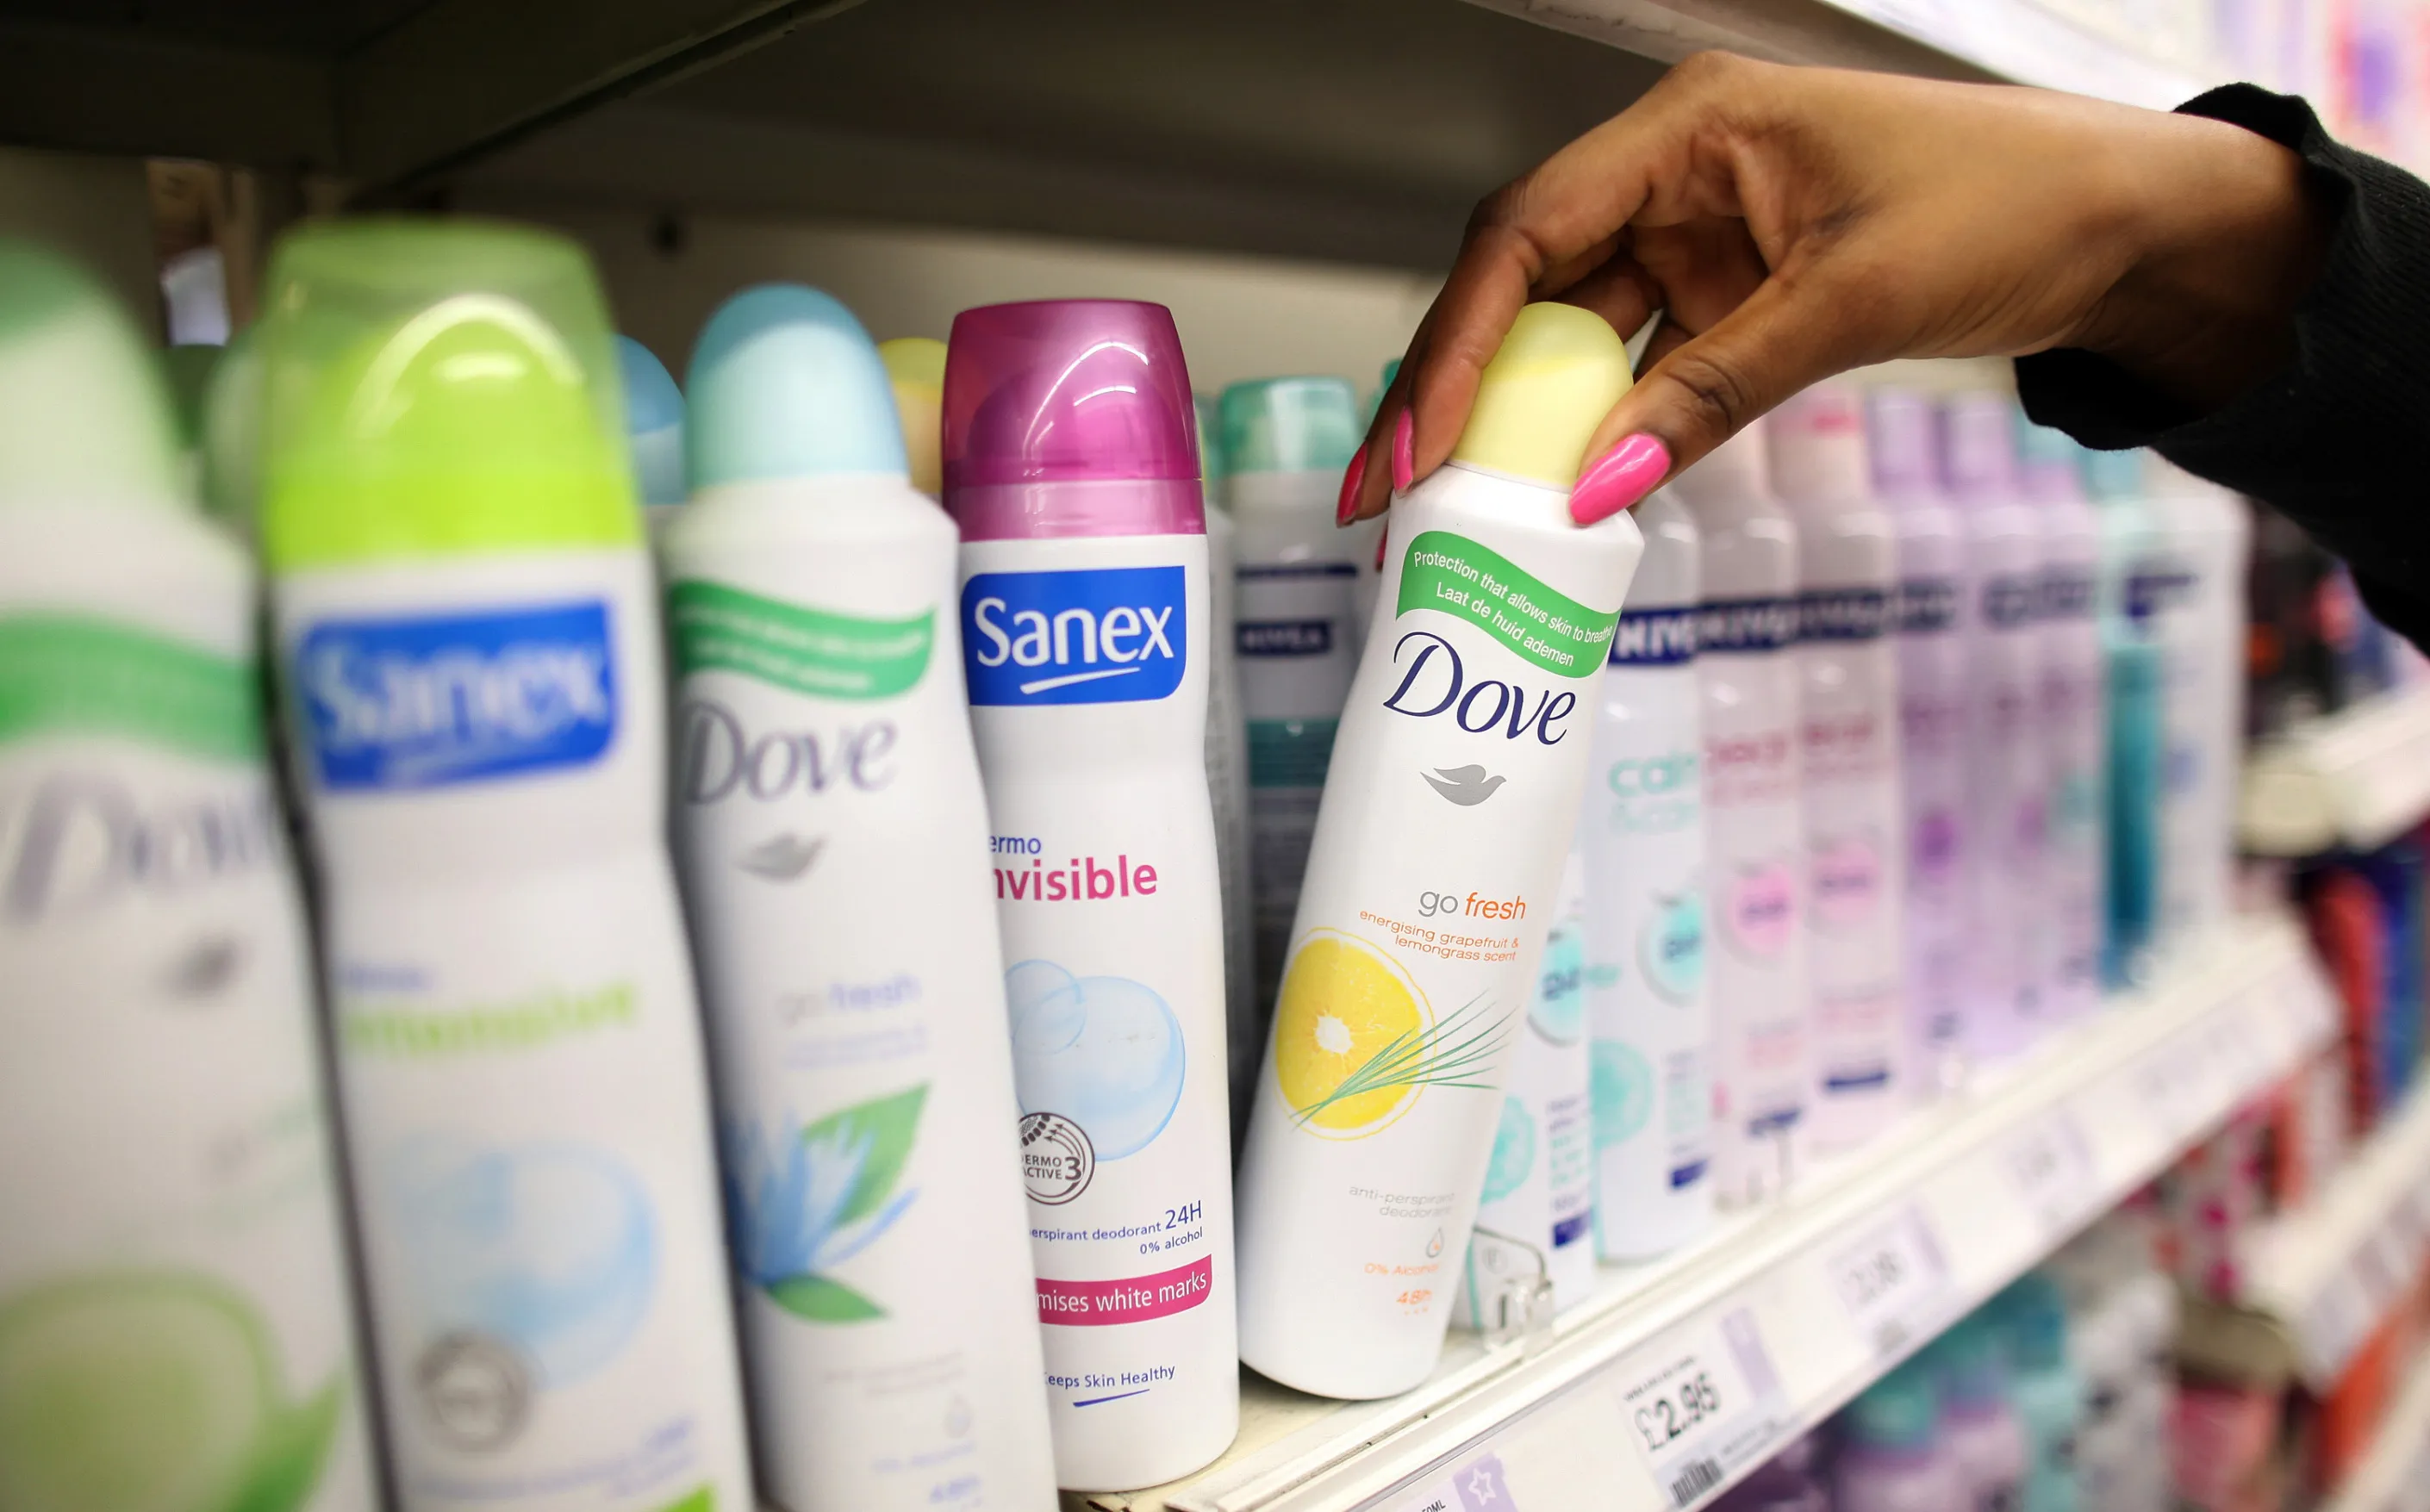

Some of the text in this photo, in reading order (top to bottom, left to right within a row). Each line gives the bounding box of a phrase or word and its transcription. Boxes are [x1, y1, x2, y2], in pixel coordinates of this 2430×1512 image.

[1414, 551, 1478, 582] Protection
[1481, 573, 1508, 600] that
[1508, 594, 1548, 623] allows
[1548, 617, 1572, 638] skin
[1573, 625, 1583, 641] to
[975, 597, 1174, 667] Sanex
[1436, 582, 1573, 667] Laat de huid ademen
[312, 643, 607, 744] Sanex
[1383, 632, 1576, 745] Dove
[686, 700, 898, 806] Dove
[1418, 891, 1526, 919] go fresh
[1360, 911, 1518, 949] energising grapefruit &
[1395, 935, 1516, 961] lemongrass scent
[1022, 1154, 1062, 1167] ERMO
[1065, 1156, 1082, 1180] 3
[1349, 1186, 1455, 1205] anti-perspirant
[1030, 1200, 1202, 1241] erspirant deodorant 24H
[1140, 1227, 1202, 1254] 0% alcohol
[1096, 1288, 1152, 1311] white
[1159, 1271, 1206, 1304] marks
[1045, 1366, 1175, 1389] eeps Skin Healthy
[1635, 1372, 1721, 1453] £2.95
